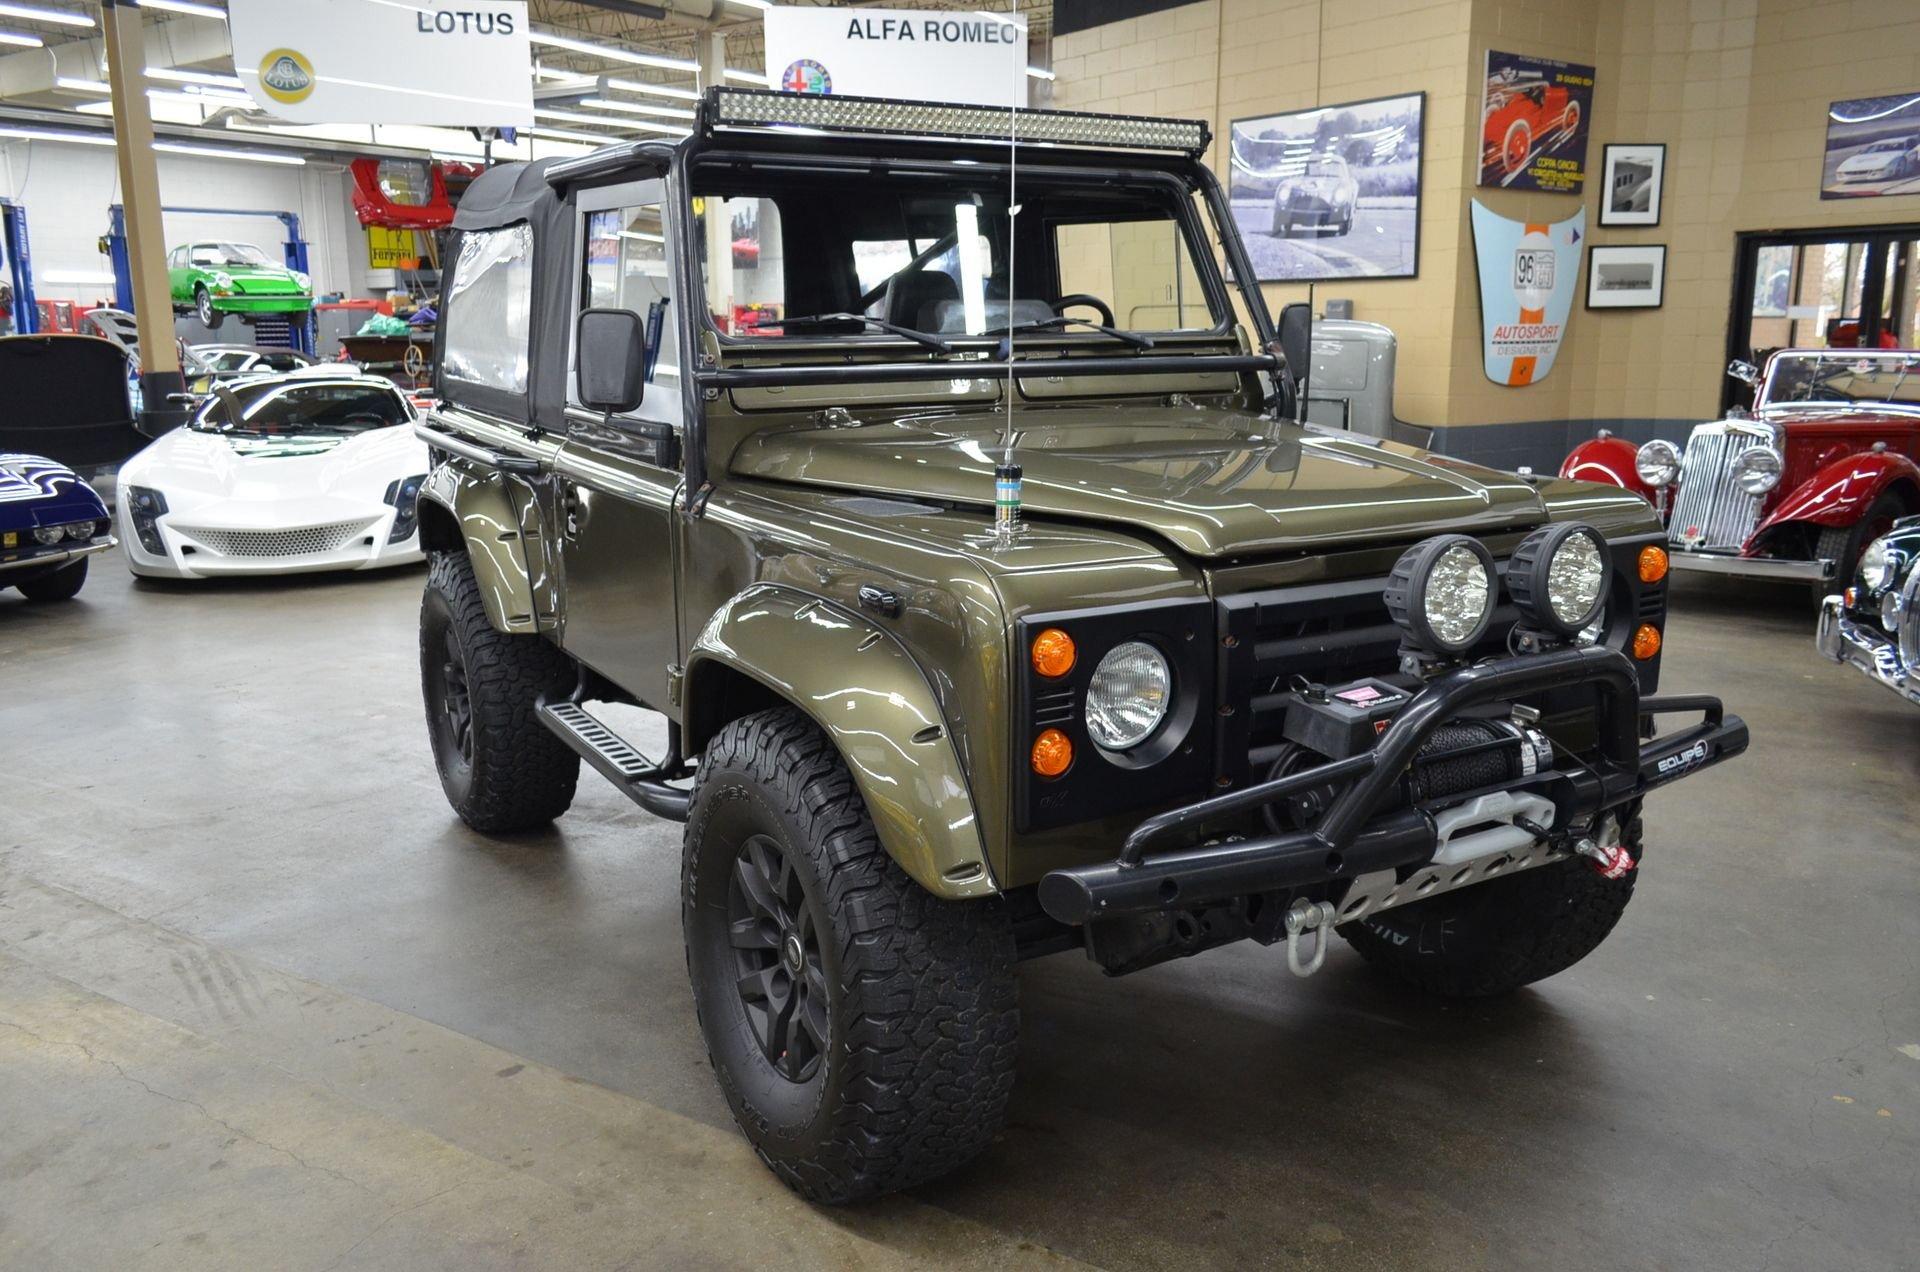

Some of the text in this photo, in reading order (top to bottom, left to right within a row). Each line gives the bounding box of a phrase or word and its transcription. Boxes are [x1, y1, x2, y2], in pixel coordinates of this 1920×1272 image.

[417, 11, 514, 35] LOTUS
[847, 18, 1019, 44] ALFA ROMEO
[1518, 255, 1534, 283] 96
[1494, 326, 1559, 339] AUTOSPORT
